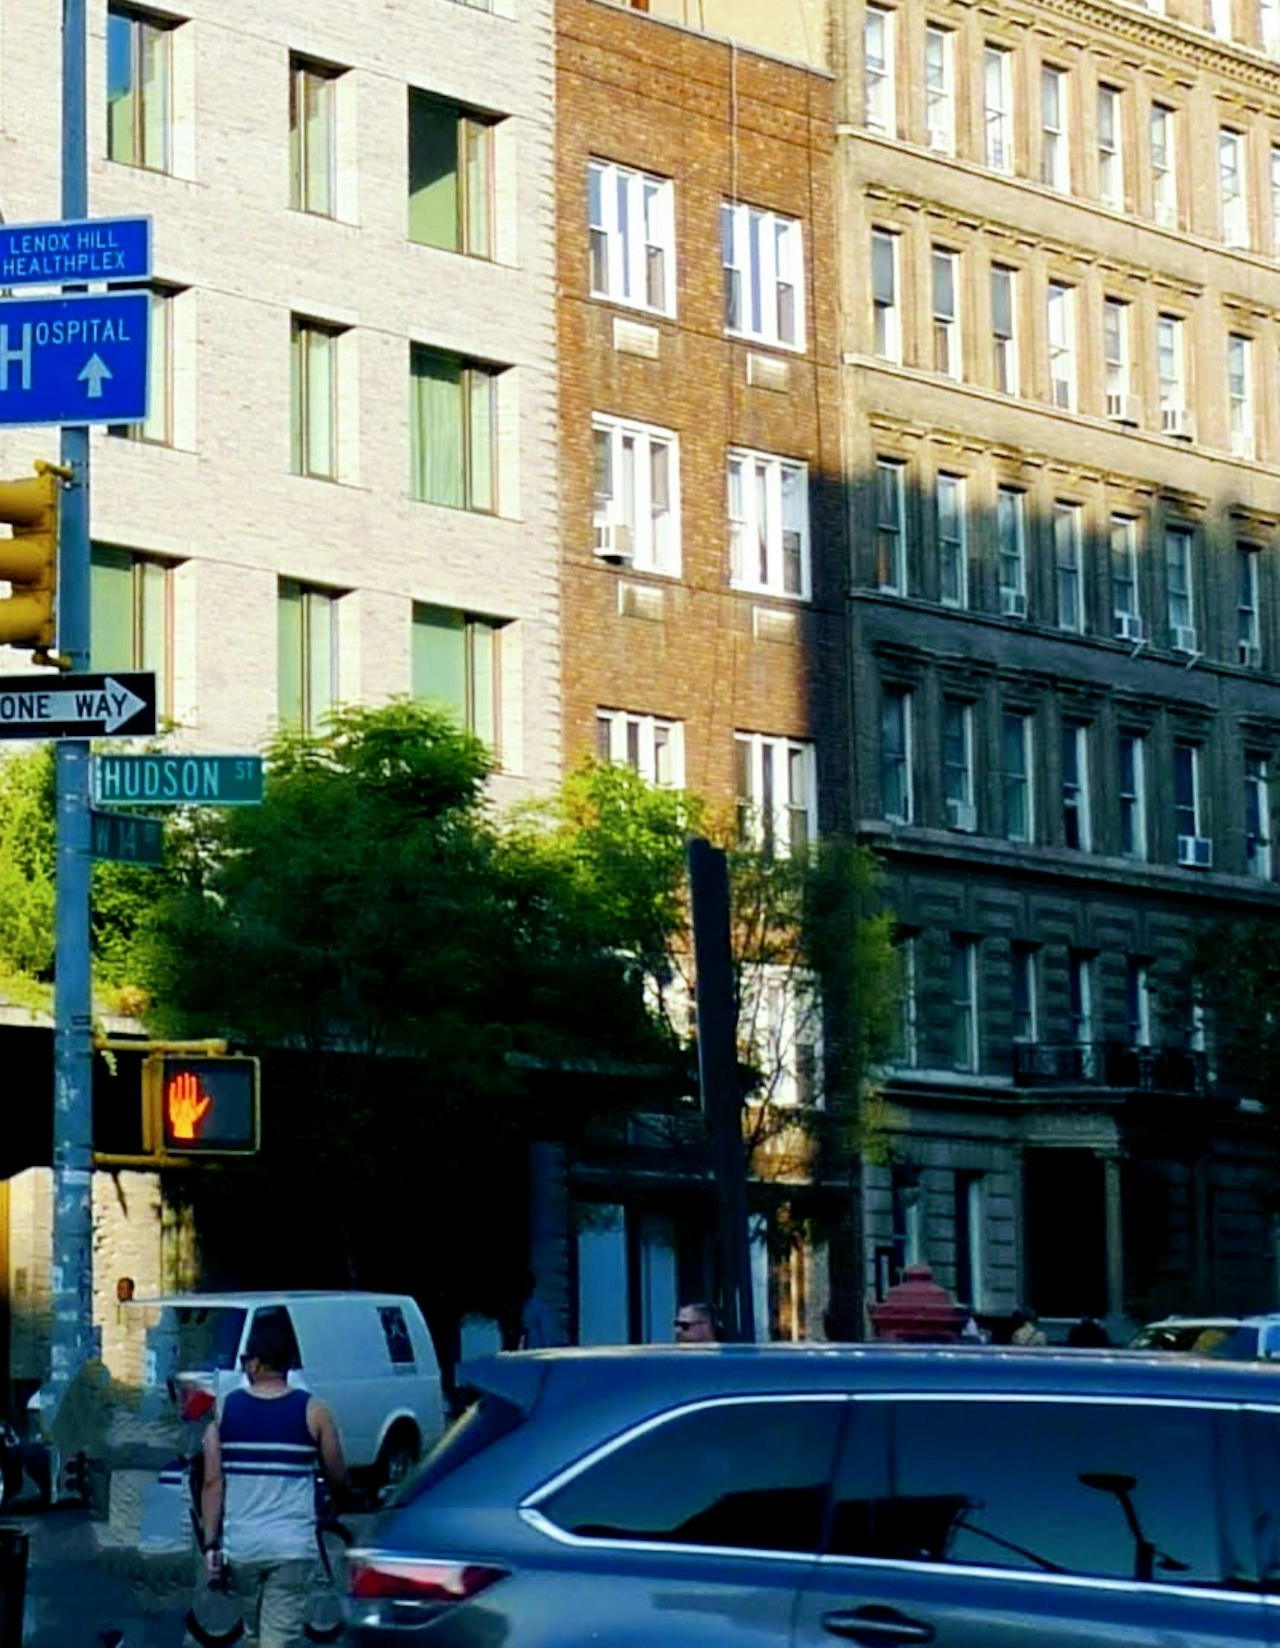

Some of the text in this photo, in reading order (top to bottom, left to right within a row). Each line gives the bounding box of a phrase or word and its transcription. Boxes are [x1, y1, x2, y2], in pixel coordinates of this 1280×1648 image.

[10, 230, 119, 255] LENOX HILL
[2, 251, 126, 277] HEALTHPLEX
[0, 693, 128, 719] ONE WAY
[104, 760, 255, 797] HUDSON ST
